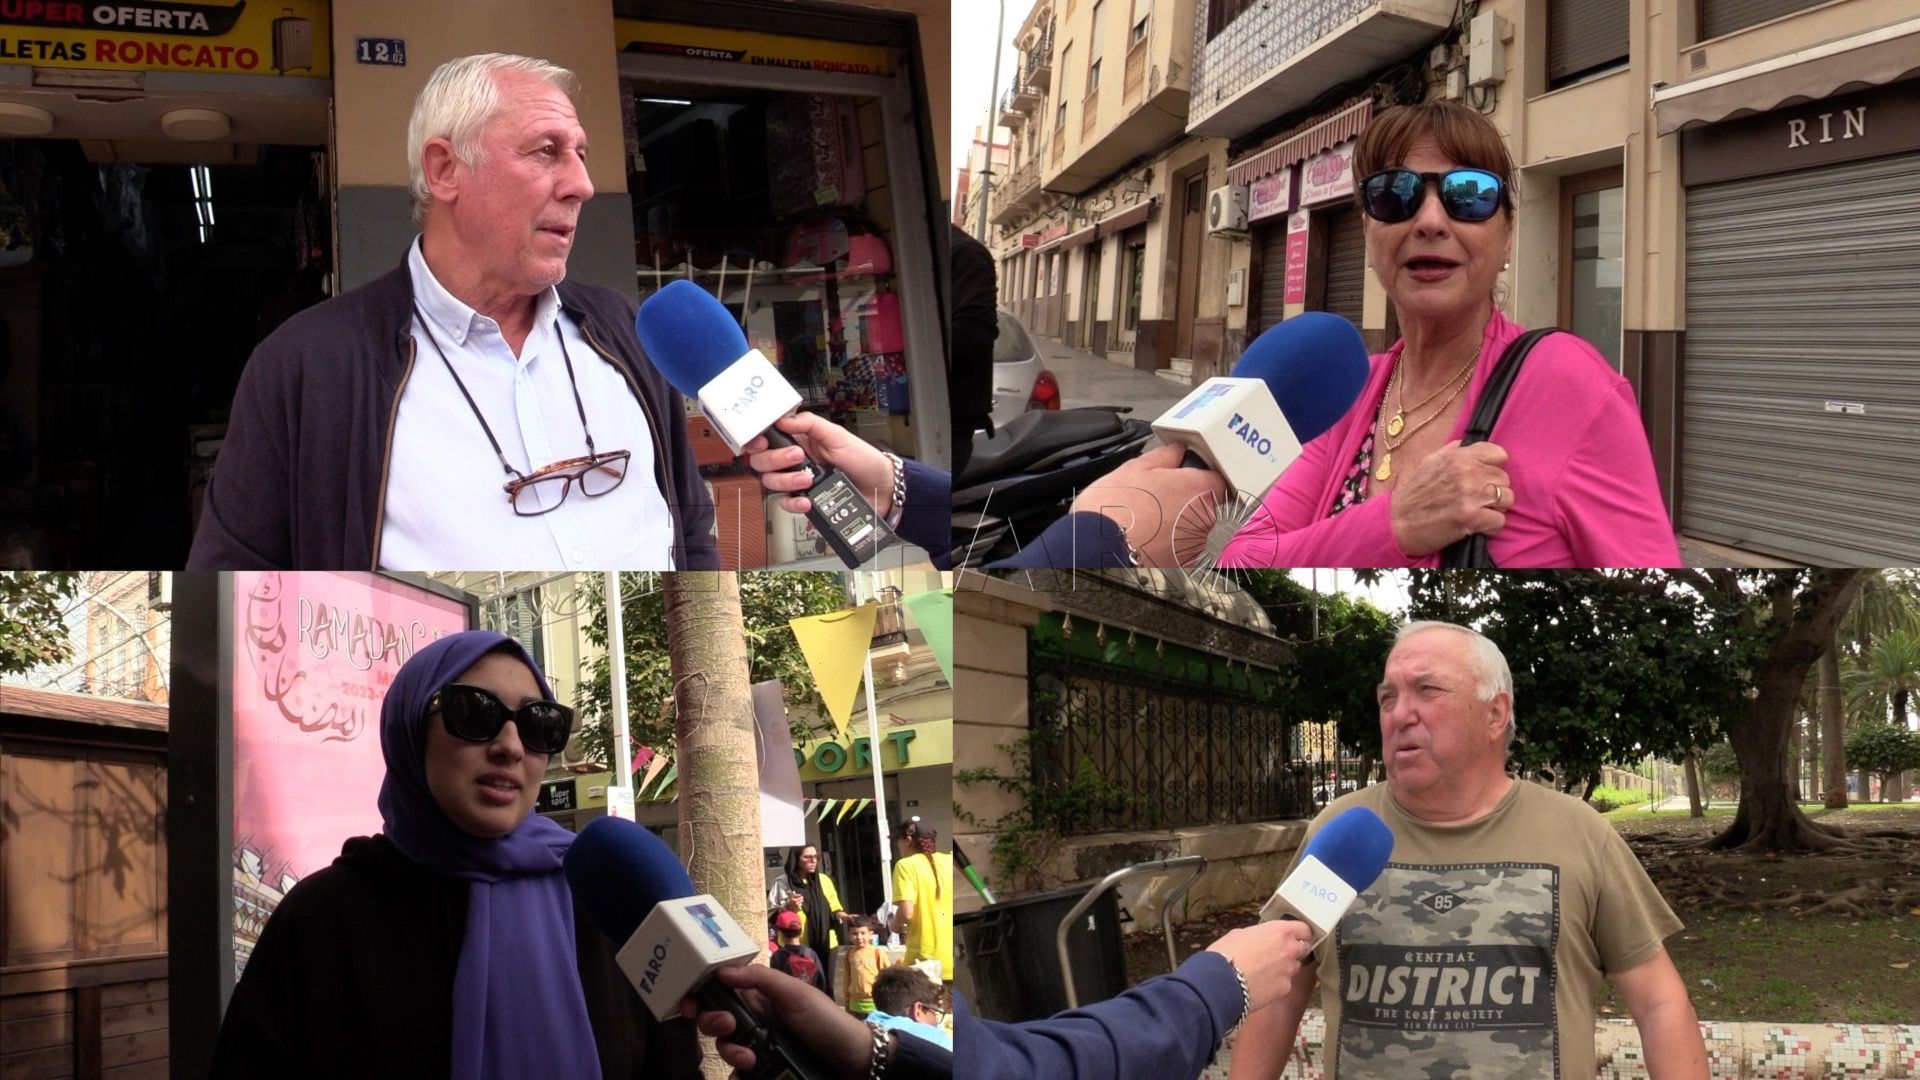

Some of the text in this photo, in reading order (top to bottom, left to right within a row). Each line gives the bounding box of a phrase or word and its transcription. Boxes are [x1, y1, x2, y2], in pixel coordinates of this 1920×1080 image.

[0, 0, 210, 31] UPER OFERTA
[0, 38, 260, 70] LETAS RONCATO
[360, 41, 389, 62] 12
[685, 48, 733, 60] OFERTA
[751, 56, 765, 65] EN
[766, 57, 812, 70] MALETAS
[813, 60, 870, 75] RONCATO
[1786, 105, 1867, 149] RIN
[1226, 412, 1273, 456] FARO
[297, 594, 426, 671] RAMADAN
[1434, 895, 1453, 910] 85
[639, 944, 667, 994] FARO
[1404, 951, 1476, 963] CENTRAL
[1346, 964, 1541, 1007] DISTRICT
[1374, 1007, 1505, 1020] THE LOST SOCIETY
